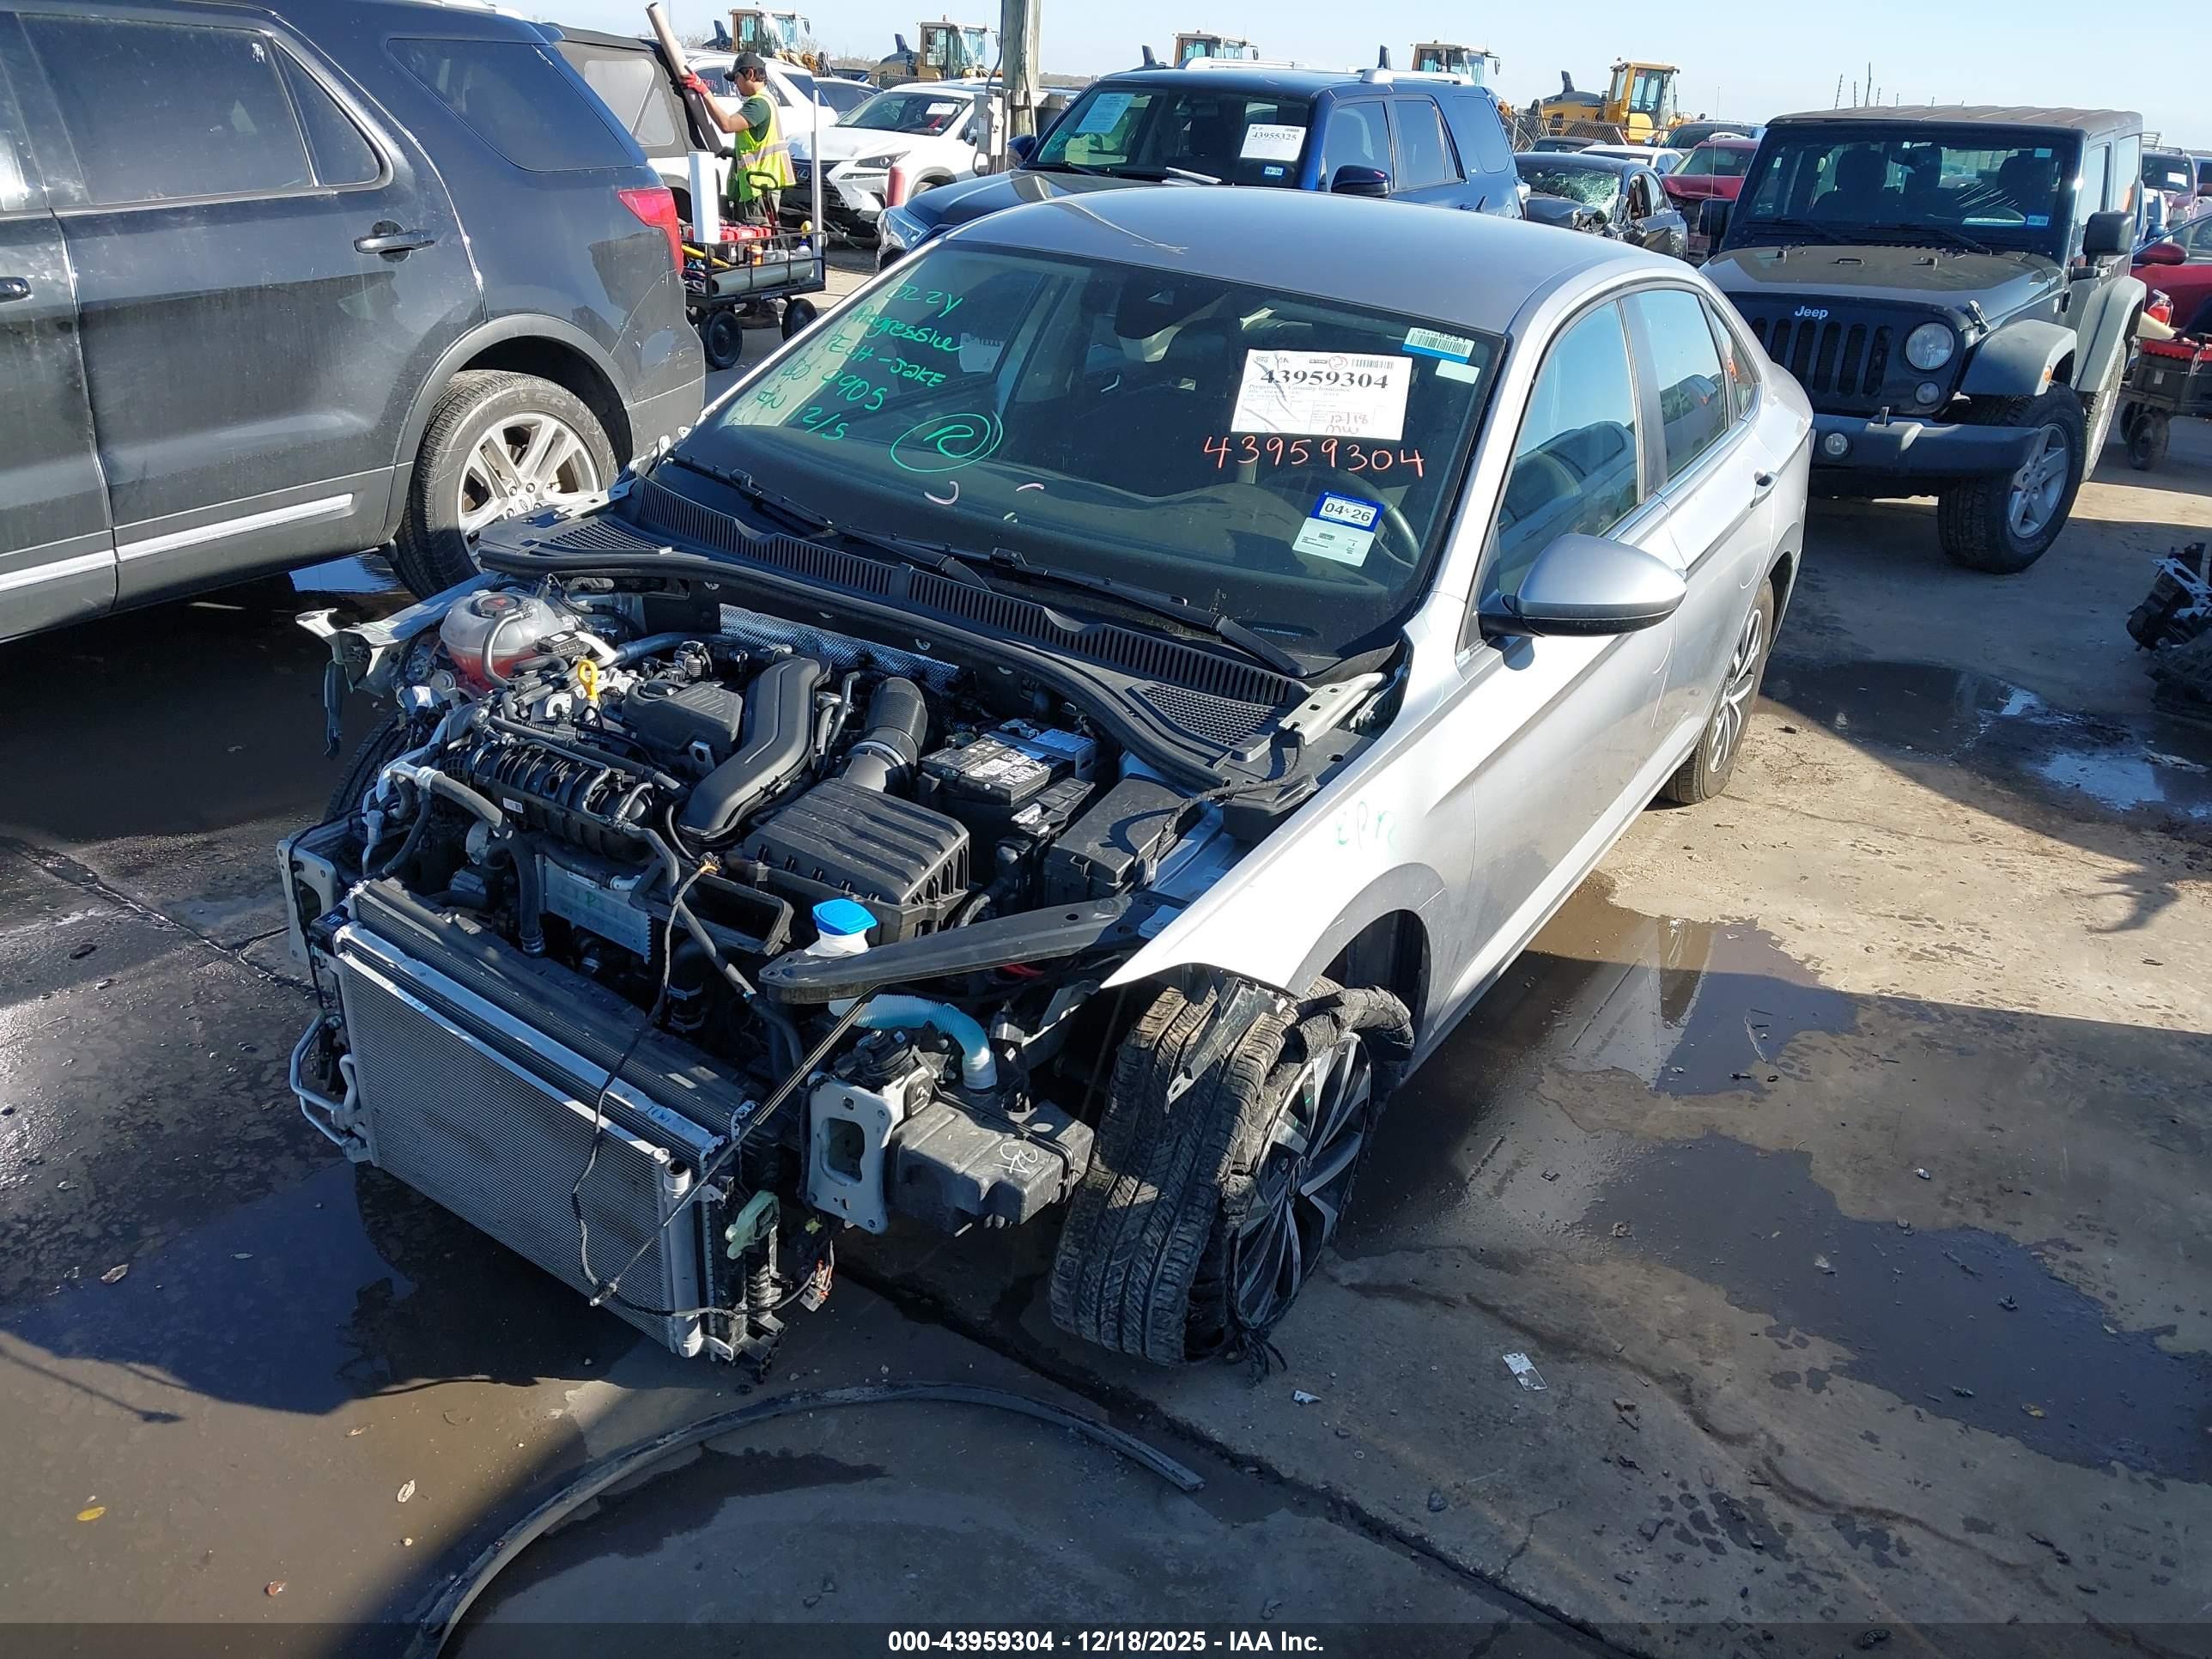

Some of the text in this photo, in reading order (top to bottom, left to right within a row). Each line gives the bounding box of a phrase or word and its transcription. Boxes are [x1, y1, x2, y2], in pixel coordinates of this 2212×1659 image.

[1795, 306, 1828, 319] Jeep
[1261, 369, 1389, 389] 43959304
[1203, 435, 1425, 478] 43959304
